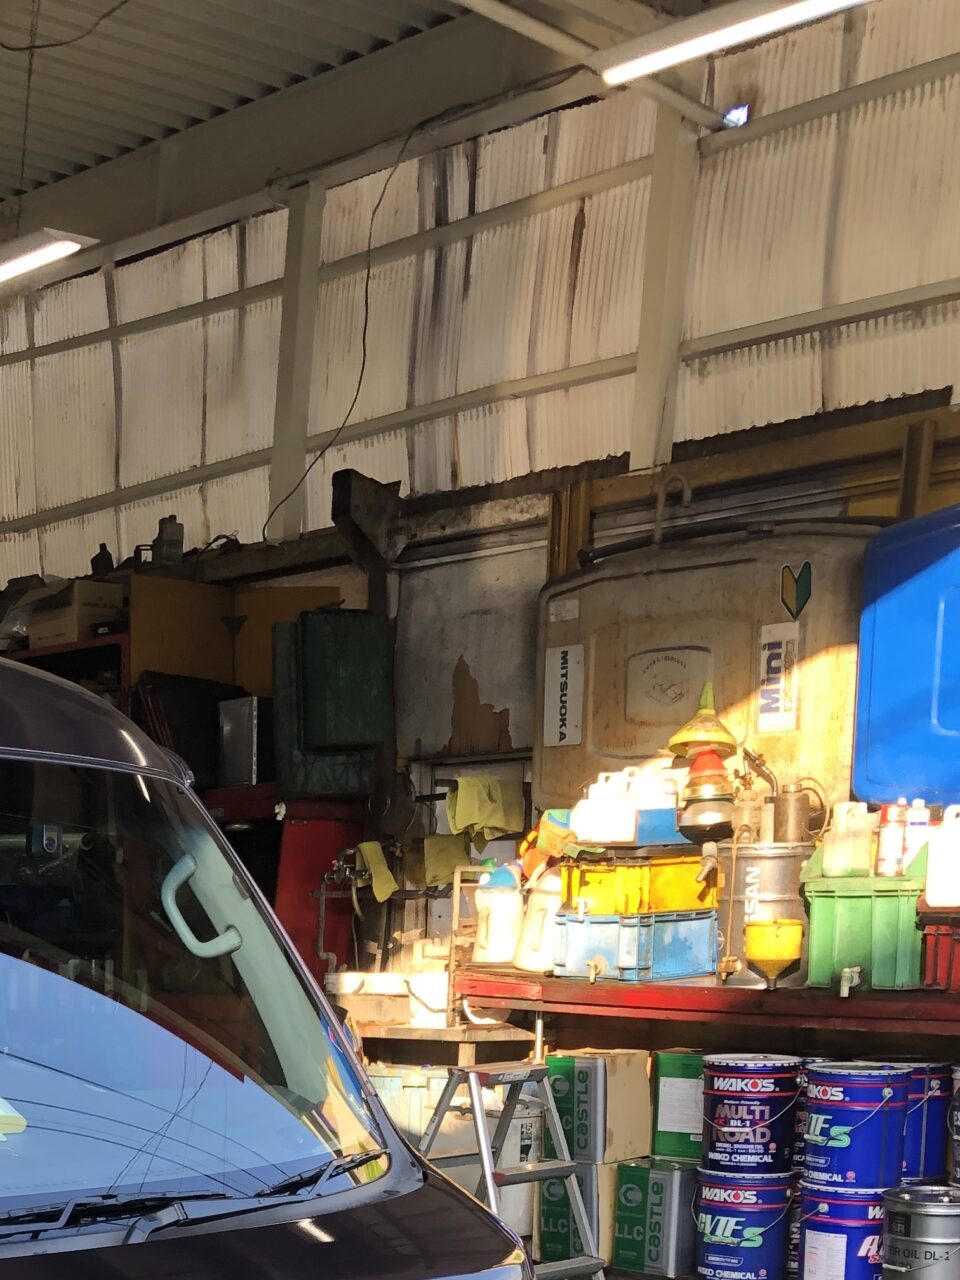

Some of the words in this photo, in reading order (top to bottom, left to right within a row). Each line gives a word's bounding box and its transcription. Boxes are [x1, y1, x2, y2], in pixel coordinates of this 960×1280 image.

[759, 641, 782, 714] Mini
[558, 650, 569, 743] MITSUOKA
[743, 866, 760, 922] SAN
[715, 1104, 770, 1120] MULTI
[730, 1119, 751, 1127] DL-1
[712, 1126, 772, 1143] ROAD
[731, 1153, 773, 1163] CHEMICAL
[808, 1171, 844, 1183] CHEMICAL
[541, 1216, 569, 1234] LLC
[614, 1221, 644, 1241] LLC
[903, 1249, 920, 1260] OIL
[924, 1250, 950, 1261] DL-1
[715, 1269, 757, 1280] CHEMICAL
